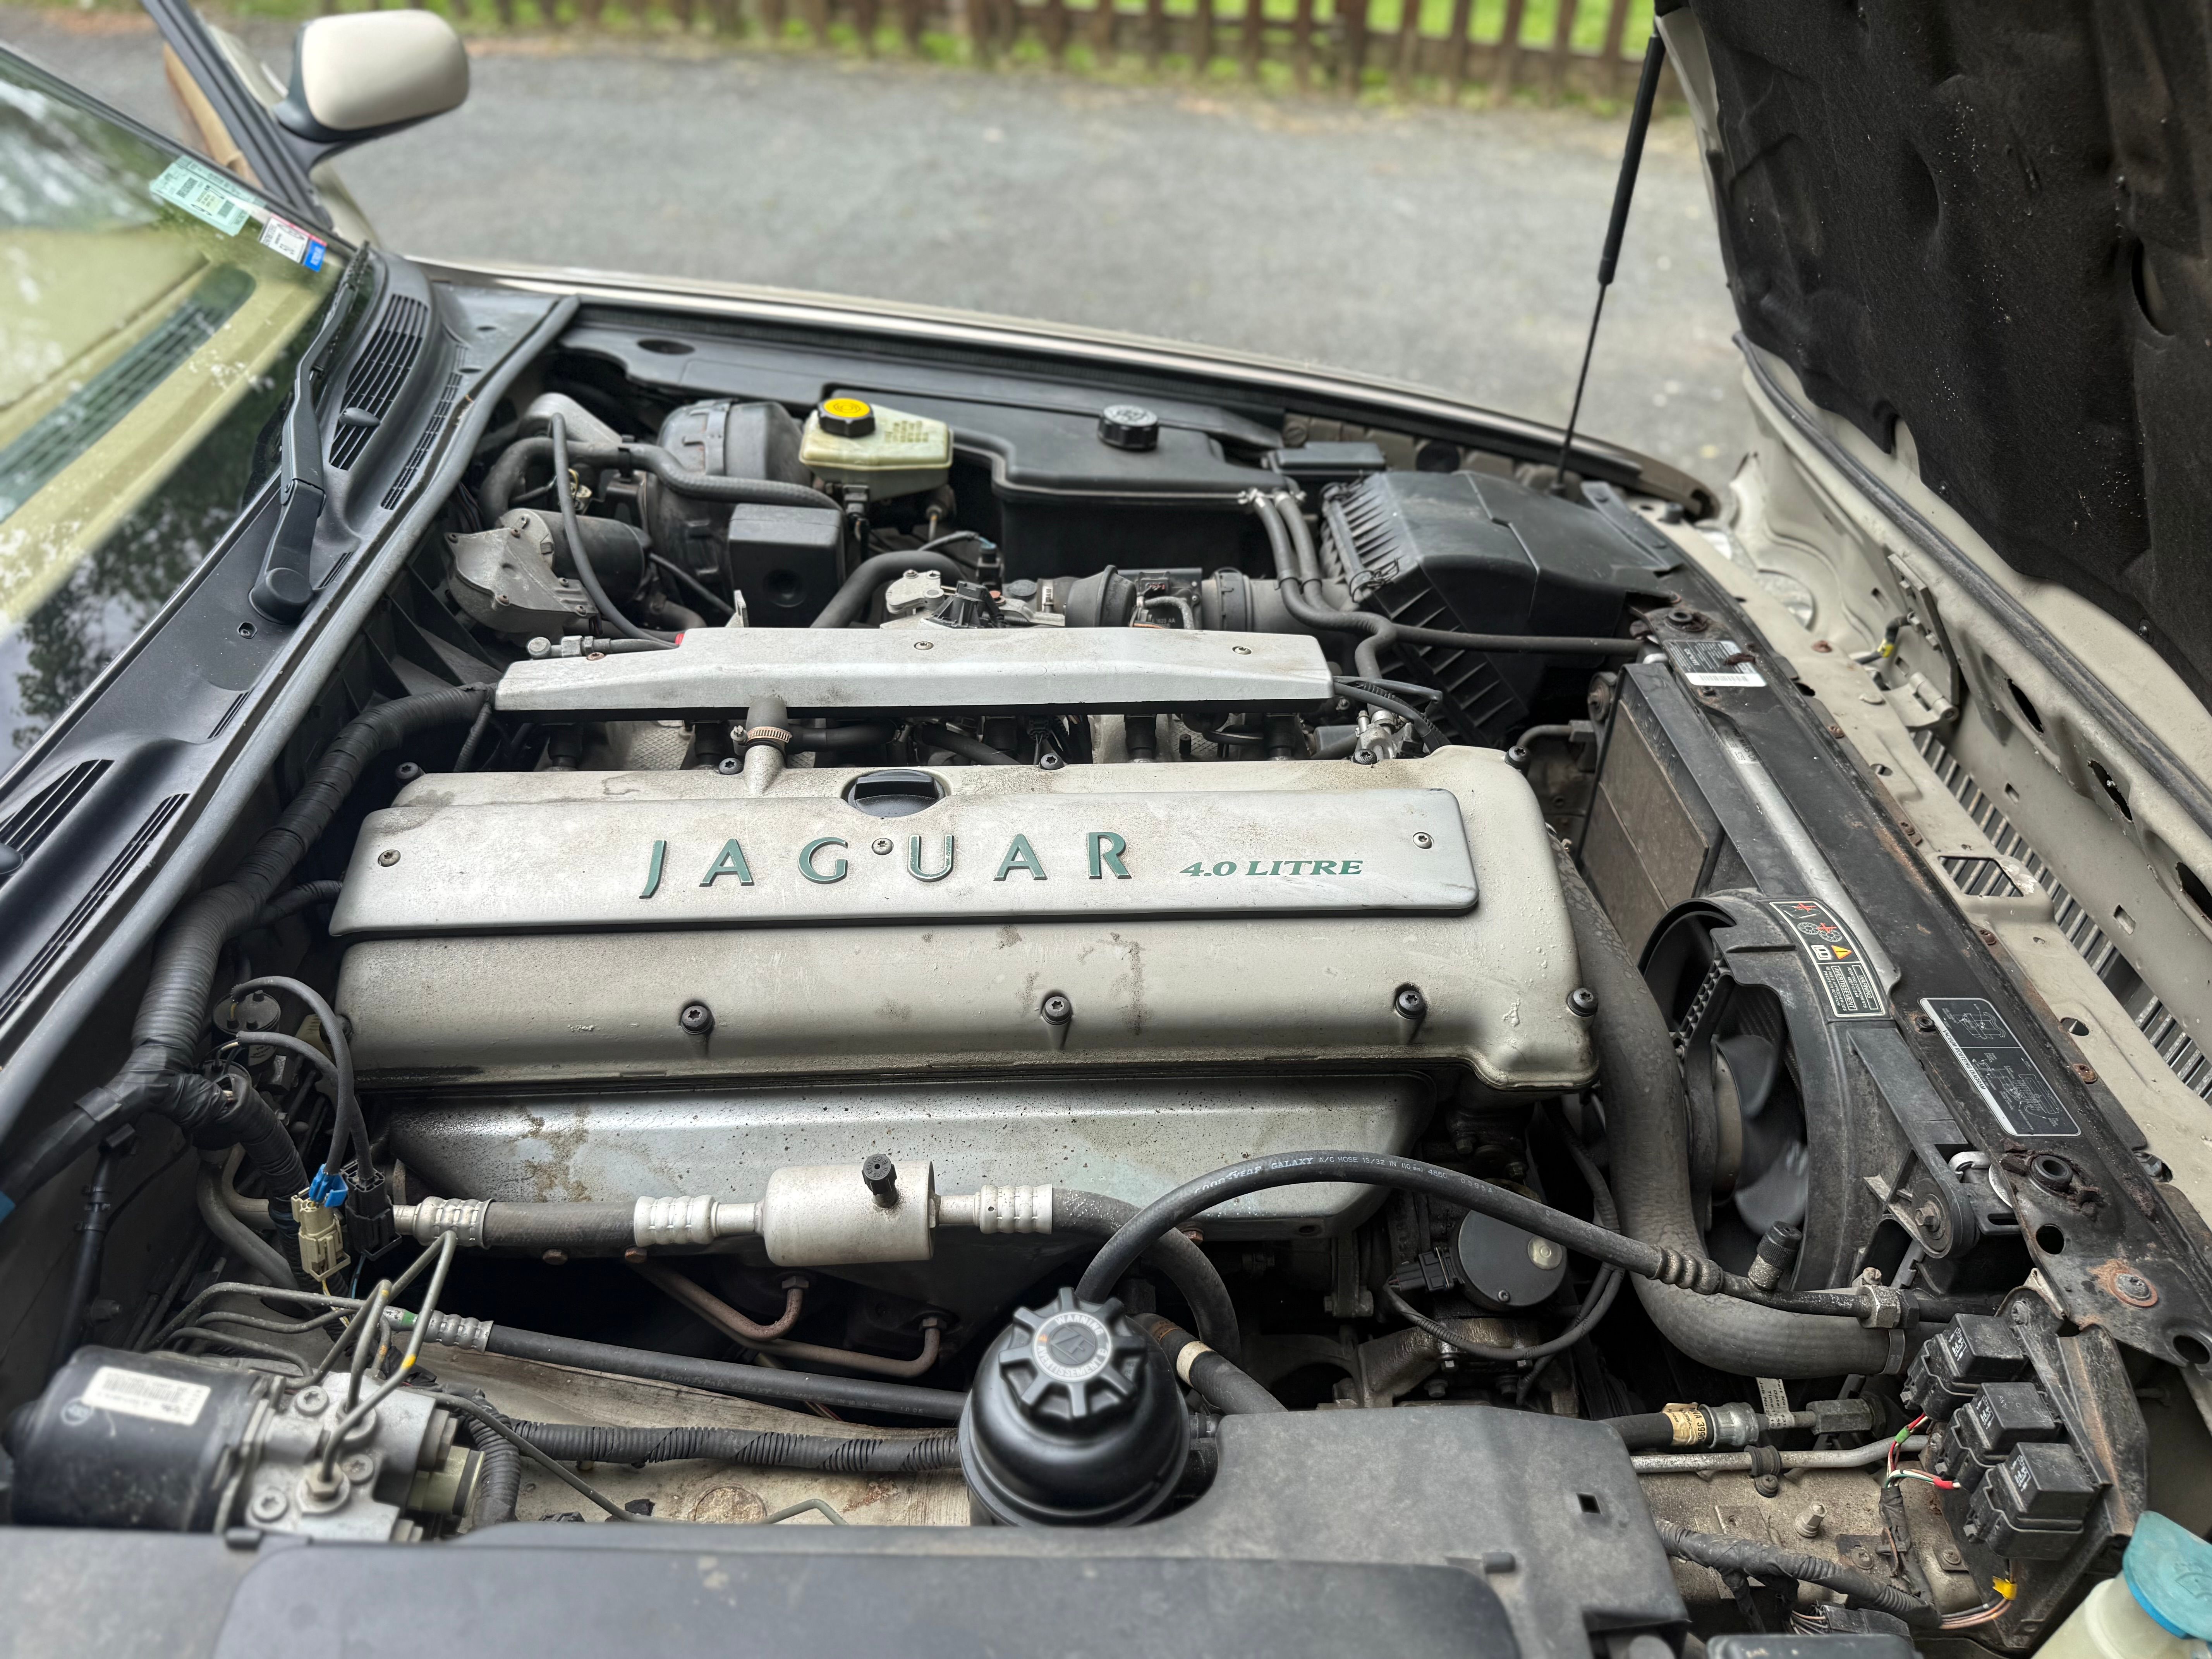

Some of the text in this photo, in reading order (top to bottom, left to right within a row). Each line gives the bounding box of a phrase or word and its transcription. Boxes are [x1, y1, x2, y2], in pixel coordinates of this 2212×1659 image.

[639, 831, 1363, 899] JAGUAR 4.0 LITRE
[1833, 967, 1855, 1008] AVERTISSEMENT
[1858, 975, 1872, 999] WARNING
[1942, 1030, 1957, 1047] VACUUM
[1954, 1048, 1972, 1069] ROUTEING
[1969, 1070, 1986, 1090] DIAGRAM
[1270, 1157, 1314, 1170] GALAXY
[1362, 1157, 1385, 1166] 13/32
[1054, 1315, 1104, 1335] WARNING
[1037, 1345, 1102, 1377] AVERTISSEMENT
